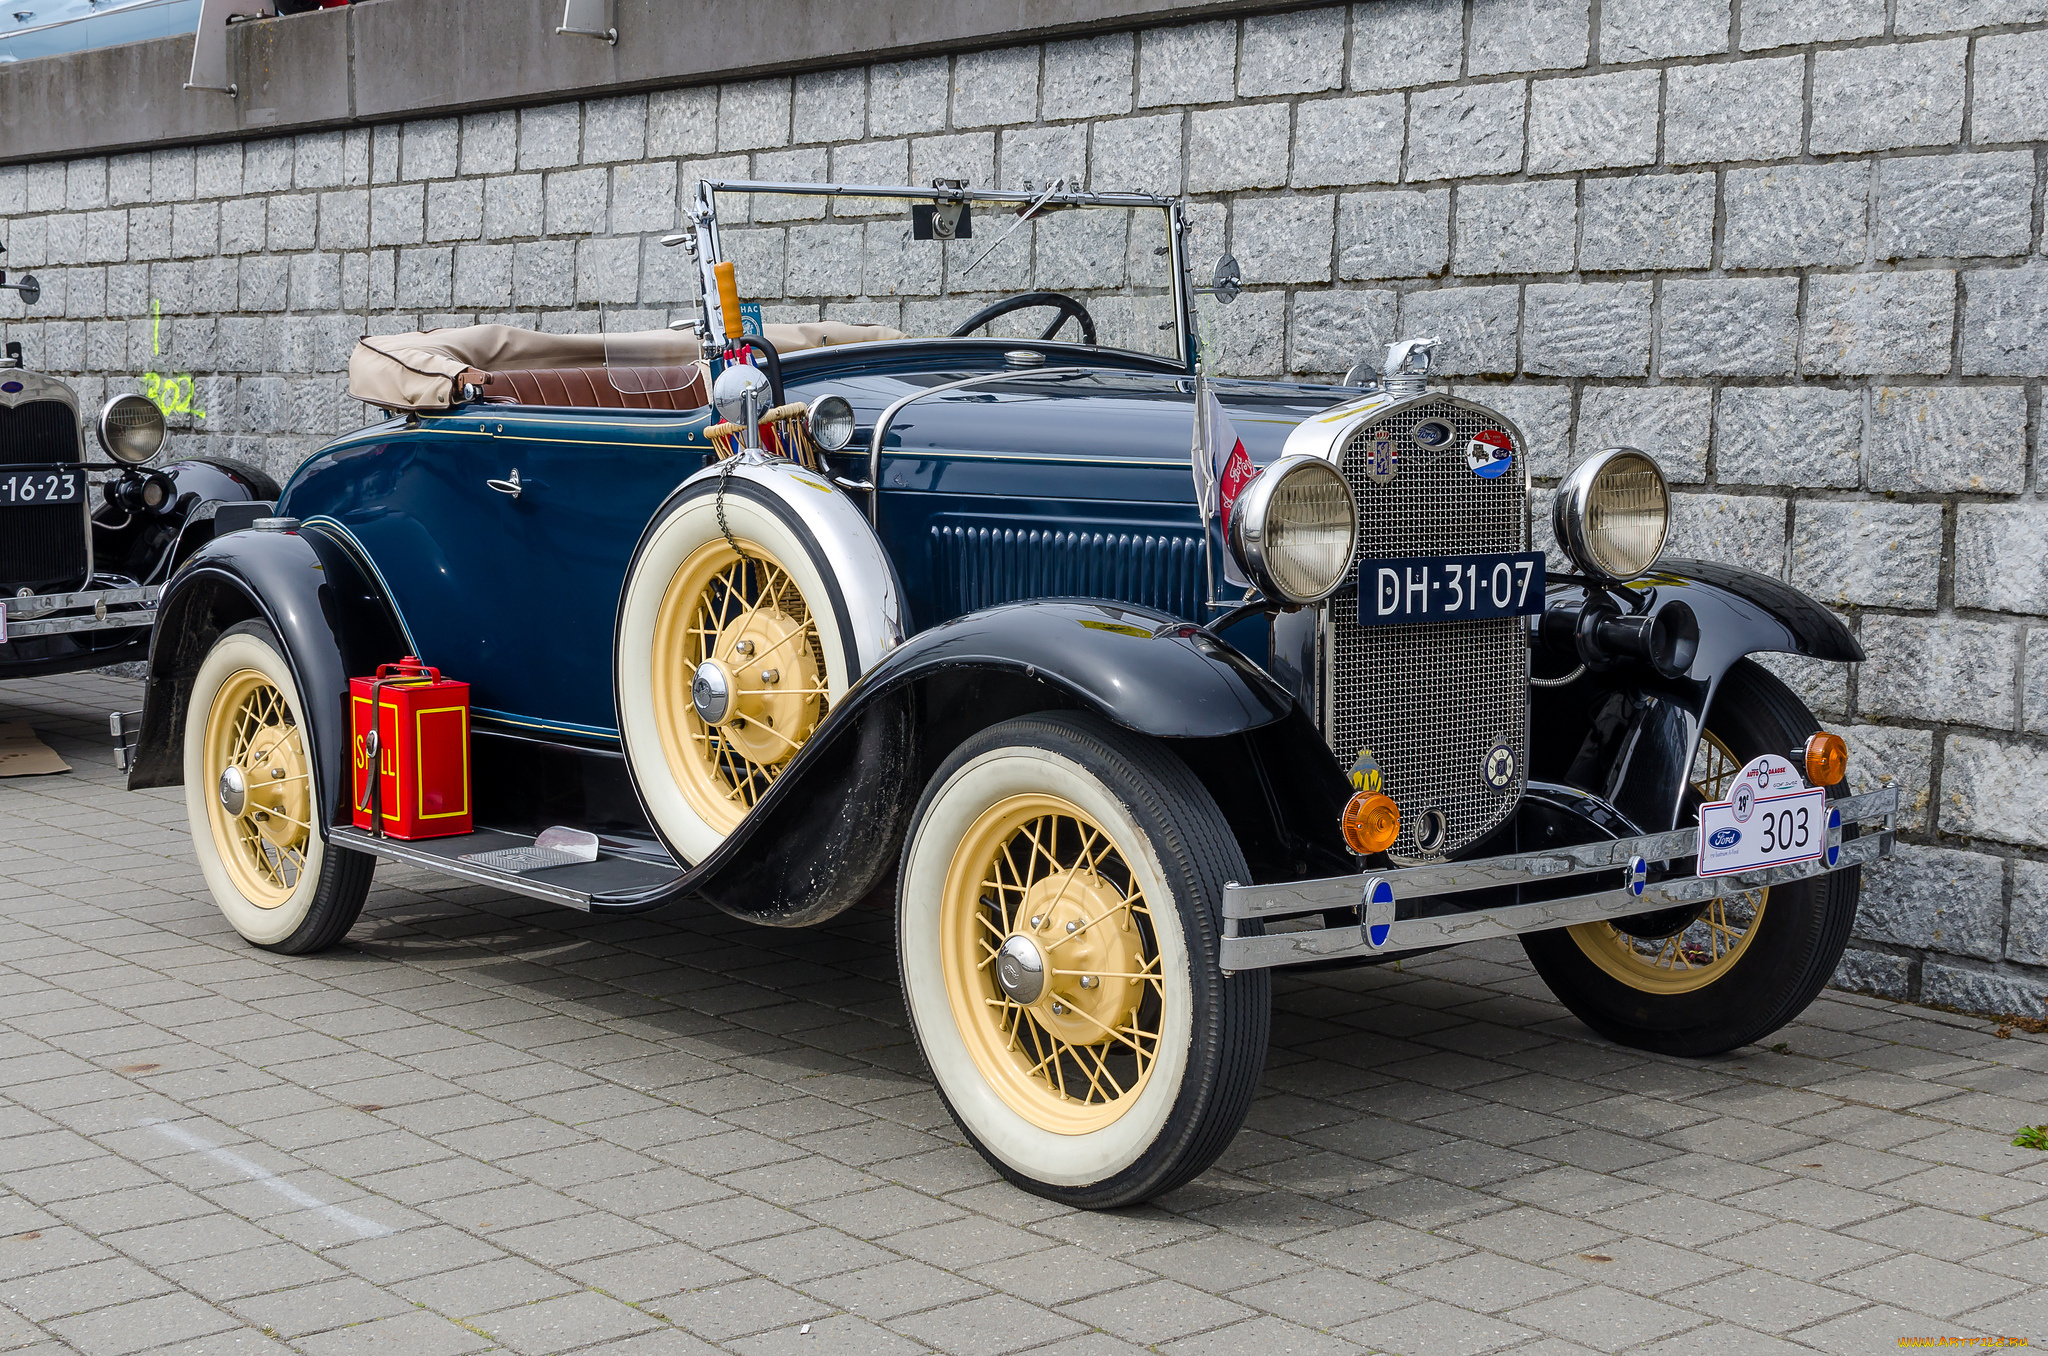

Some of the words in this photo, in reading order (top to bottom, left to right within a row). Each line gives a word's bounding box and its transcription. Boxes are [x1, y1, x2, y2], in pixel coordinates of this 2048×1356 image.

[1377, 561, 1534, 616] DH-31-07
[356, 734, 396, 777] SLL
[1714, 830, 1736, 846] Ford
[1760, 807, 1809, 854] 303
